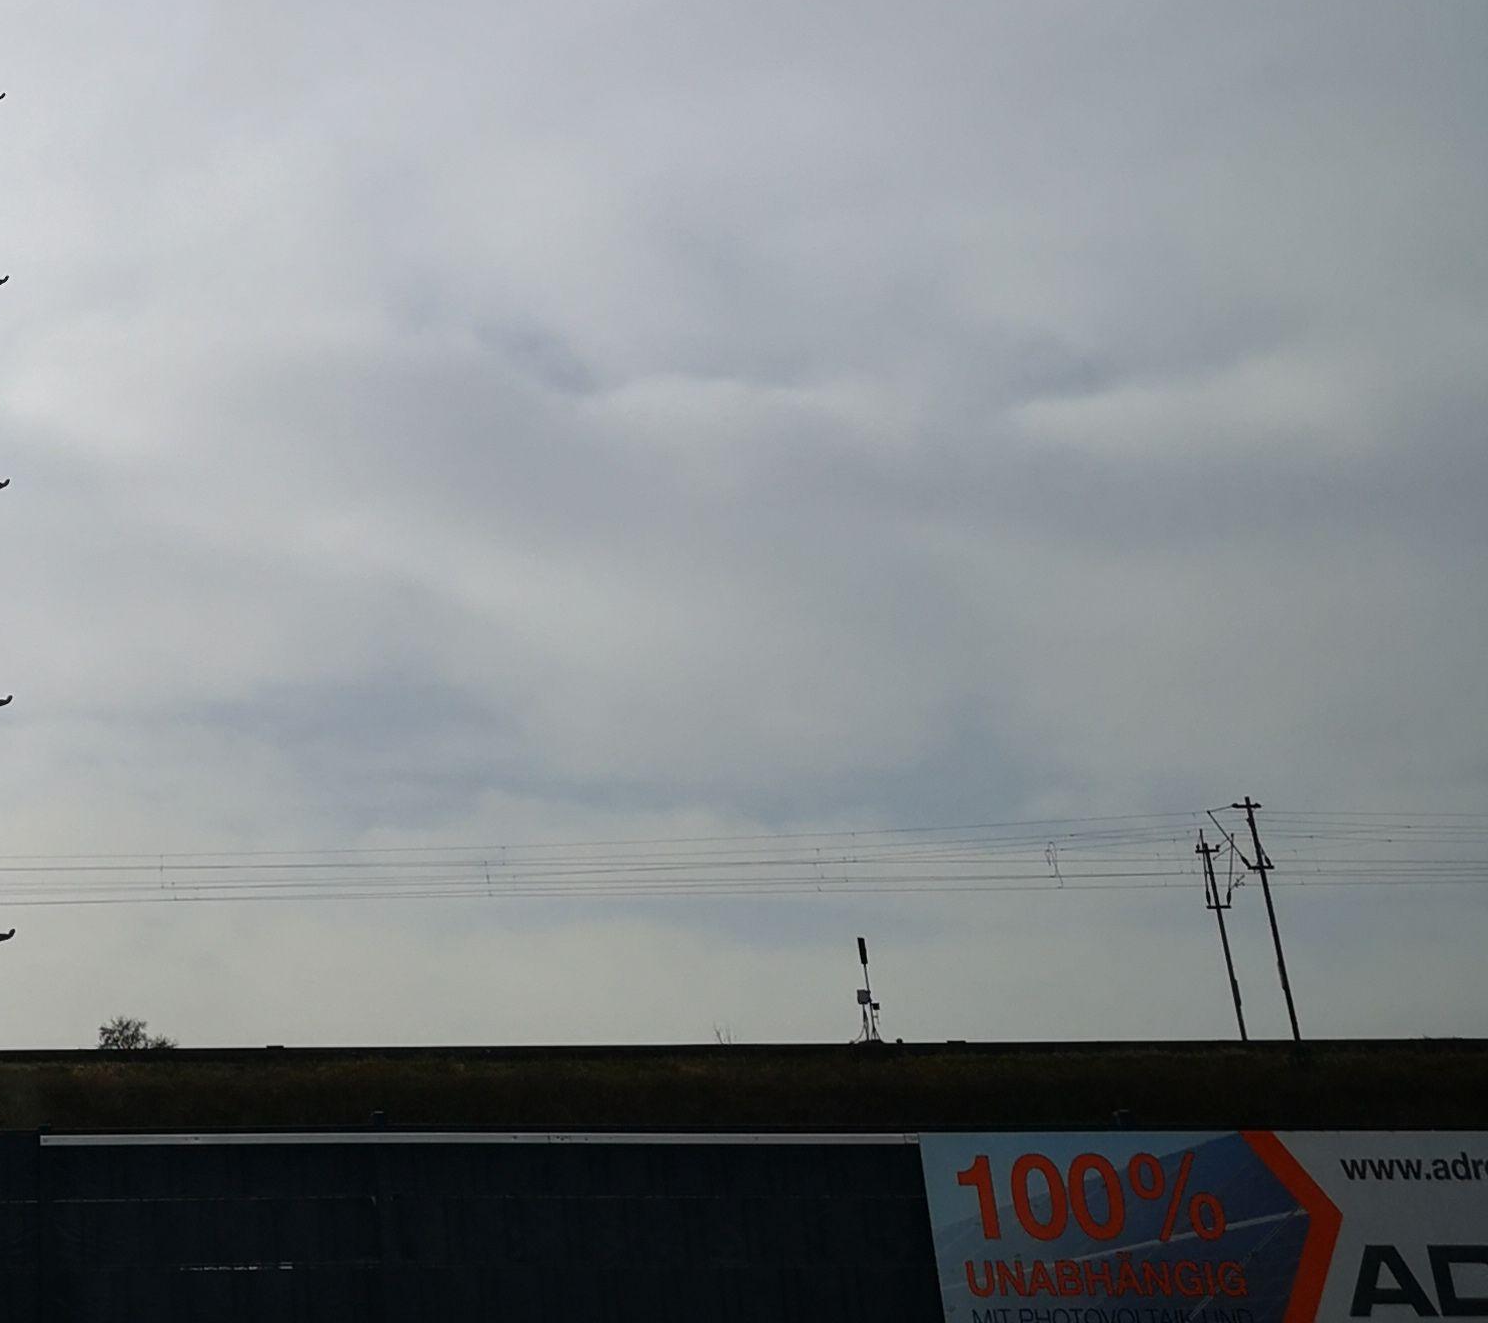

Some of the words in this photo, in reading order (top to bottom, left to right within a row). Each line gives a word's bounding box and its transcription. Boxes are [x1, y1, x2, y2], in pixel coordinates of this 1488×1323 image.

[957, 1152, 1226, 1241] 100%
[965, 1251, 1248, 1296] UNABHÄNGIG
[972, 1308, 1011, 1323] MIT
